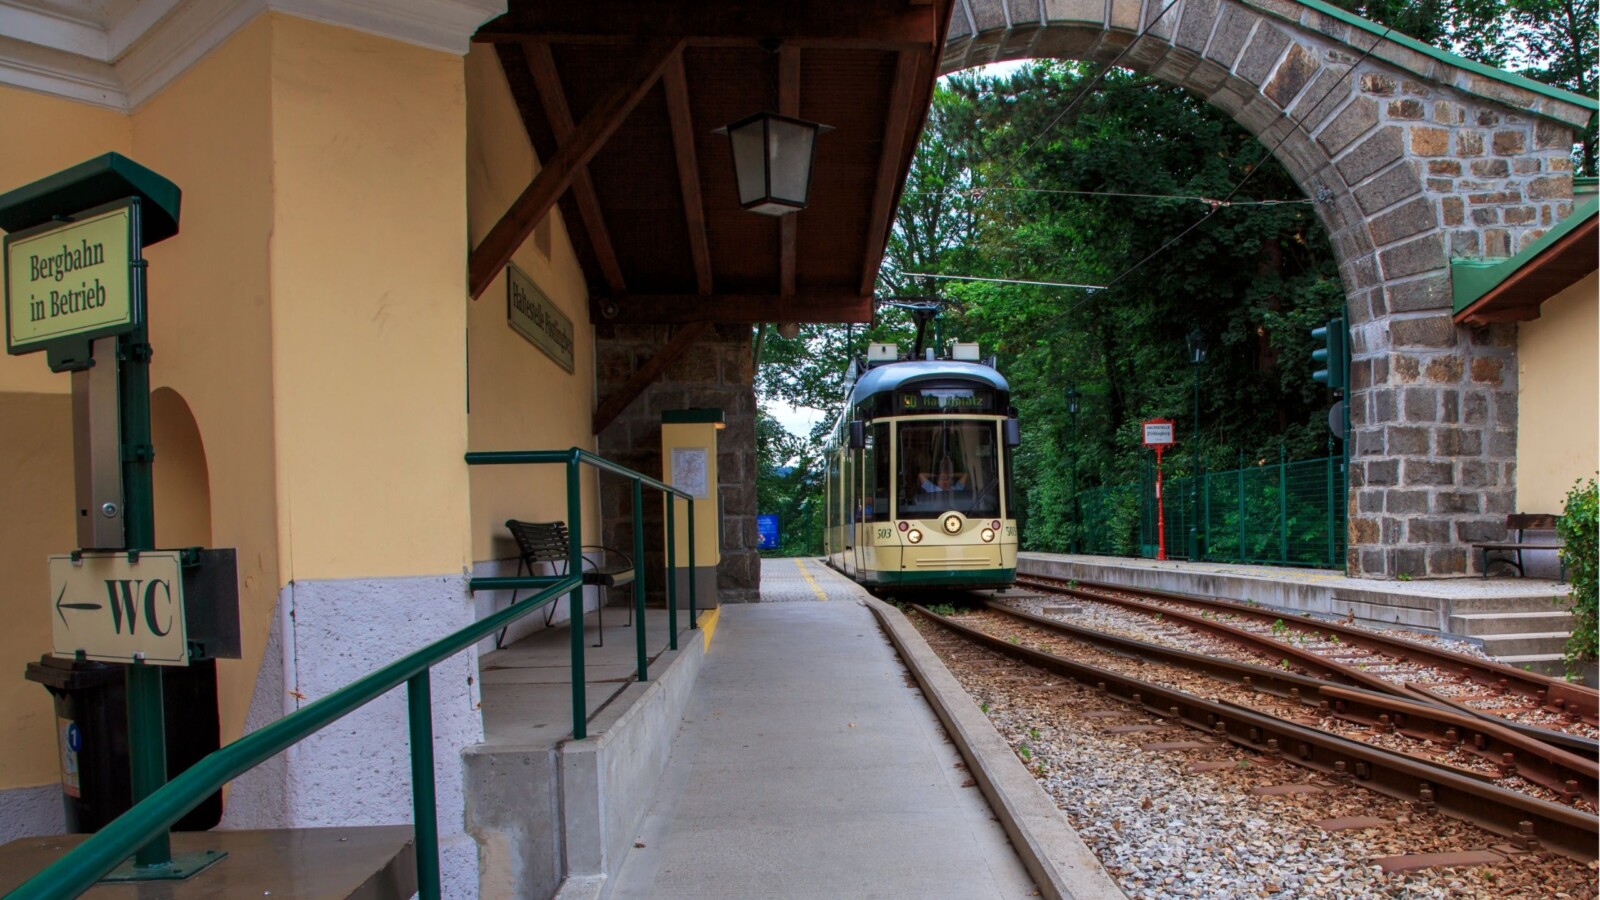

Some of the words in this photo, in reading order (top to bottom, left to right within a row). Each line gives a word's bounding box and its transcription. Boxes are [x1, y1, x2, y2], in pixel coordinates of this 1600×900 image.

[30, 239, 104, 282] Bergbahn
[30, 294, 46, 322] in
[50, 278, 106, 318] Betrieb
[512, 282, 545, 332] Haltestelle
[904, 394, 917, 408] 50
[923, 395, 984, 408] Haptplatz
[877, 528, 892, 540] 503
[104, 578, 173, 637] WC
[70, 728, 77, 747] 1
